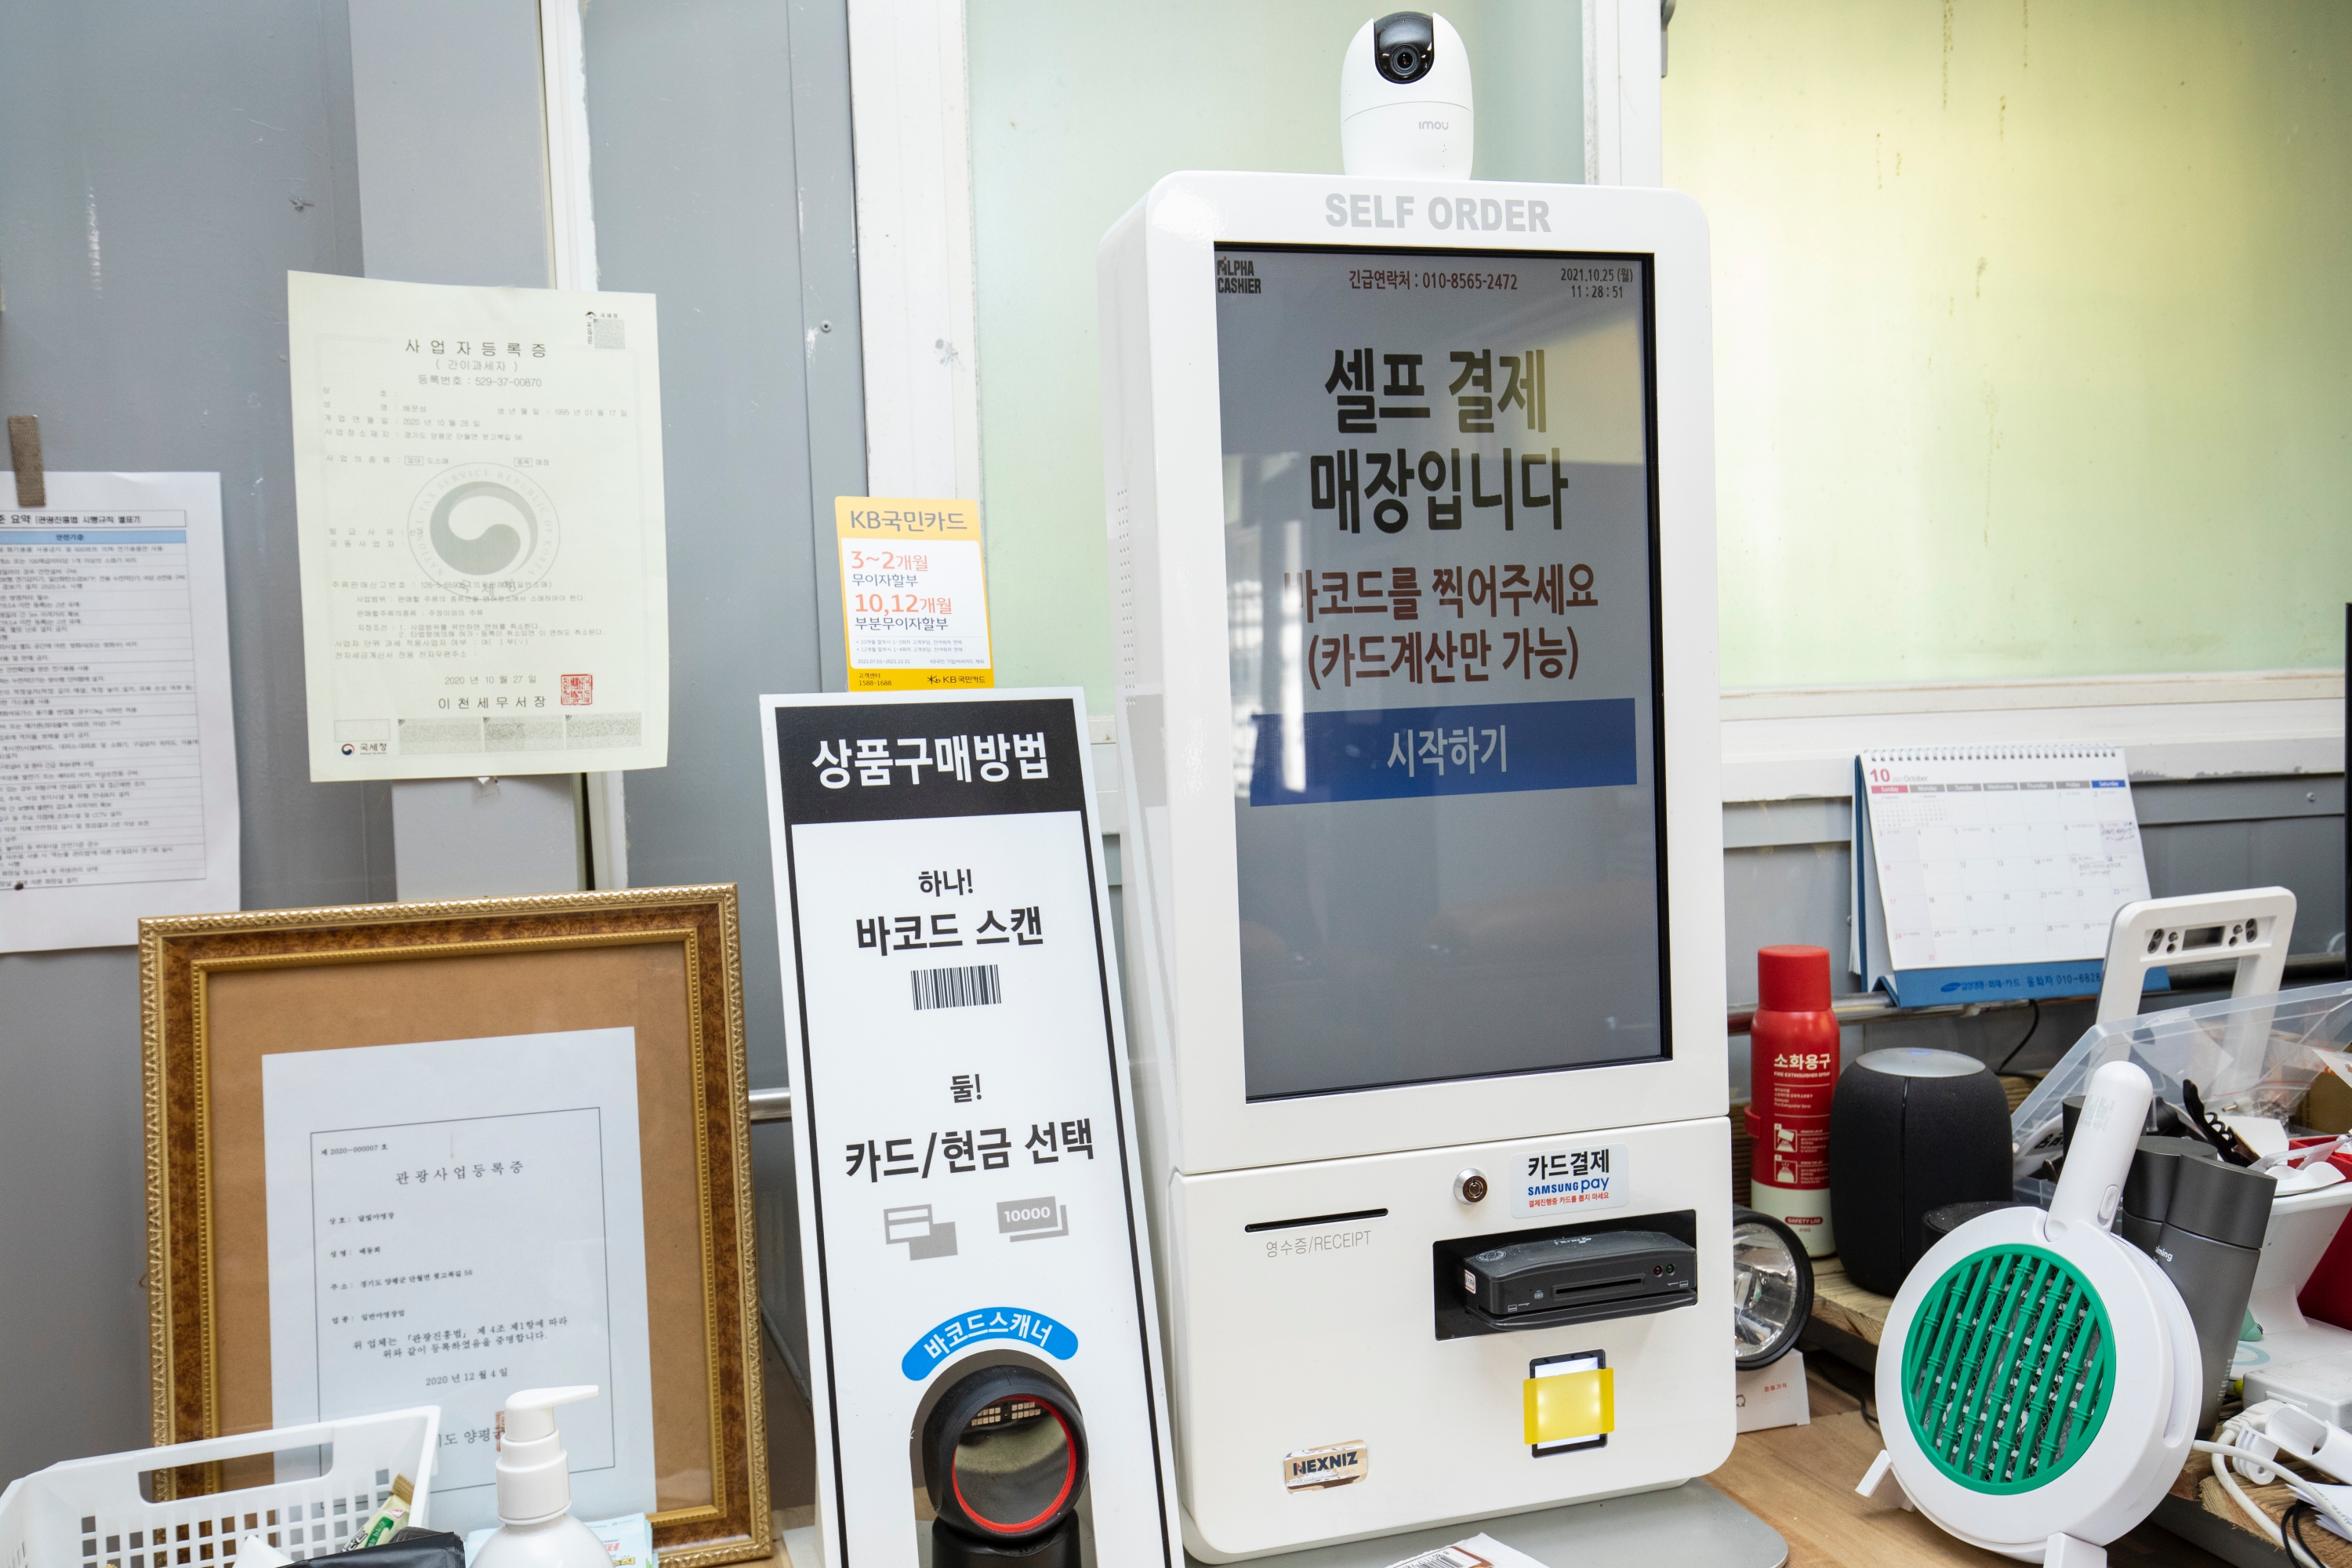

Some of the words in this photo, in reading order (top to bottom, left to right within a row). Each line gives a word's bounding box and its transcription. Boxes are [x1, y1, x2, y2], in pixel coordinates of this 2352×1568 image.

[1326, 194, 1414, 229] SELF
[1428, 197, 1552, 233] ORDER
[1217, 257, 1254, 276] ALPHA
[1560, 267, 1614, 282] 2021.10.25
[1617, 267, 1633, 283] (월)
[1348, 269, 1411, 291] 긴급연락처
[1422, 271, 1518, 292] 010-8565-2472
[405, 339, 546, 358] 사업자등록증
[418, 374, 463, 385] 등록번호
[475, 377, 542, 387] 529-37-00870
[1325, 347, 1431, 434] 셀프
[1449, 348, 1548, 434] 결제
[1310, 447, 1569, 534] 매장입니다
[850, 510, 967, 532] KB국민카드
[851, 551, 928, 572] 3~2개월
[851, 574, 919, 587] 무이자할부
[1284, 566, 1422, 623] 바코드를
[1432, 563, 1599, 619] 찍어주세요
[855, 593, 953, 616] 10,12개월
[855, 617, 949, 631] 부분무이자할부
[1308, 629, 1492, 690] (카드계산만
[1502, 626, 1579, 681] 가능)
[445, 676, 465, 684] 2020
[470, 676, 478, 684] 년
[499, 675, 508, 684] 월
[513, 675, 523, 684] 27
[528, 675, 537, 684] 일
[359, 742, 388, 751] 국세청
[1387, 724, 1507, 778] 시작하기
[812, 732, 1049, 789] 상품구매방법
[1870, 768, 1890, 782] 10
[918, 868, 974, 897] 하나!
[856, 909, 963, 956] 바코드
[976, 906, 1044, 946] 스캔
[1773, 1053, 1831, 1070] 소화용구
[949, 1073, 982, 1104] 둘!
[330, 1145, 378, 1155] 2020-000007
[845, 1127, 1012, 1183] 카드/현금
[1024, 1118, 1094, 1165] 선택
[1528, 1149, 1610, 1180] 카드결제
[1528, 1181, 1579, 1196] SAMSUNG
[1581, 1177, 1610, 1193] pay
[1529, 1197, 1558, 1207] 결제진행중
[1559, 1195, 1577, 1204] 카드를
[1592, 1192, 1610, 1200] 마세요
[1004, 1206, 1051, 1223] 10000
[1266, 1230, 1372, 1258] 영수증/RECEIPT
[360, 1279, 382, 1288] 경기도
[384, 1276, 406, 1286] 양평군
[367, 1338, 397, 1348] 업체는
[549, 1316, 568, 1327] 따라
[924, 1312, 1053, 1359] 바코드스캐너
[383, 1348, 402, 1359] 위와
[407, 1345, 426, 1356] 같이
[426, 1376, 448, 1386] 2020
[451, 1374, 460, 1383] 년
[464, 1372, 474, 1381] 12
[478, 1370, 487, 1380] 월
[499, 1367, 508, 1377] 일
[1293, 1451, 1358, 1475] NEXNIZ
